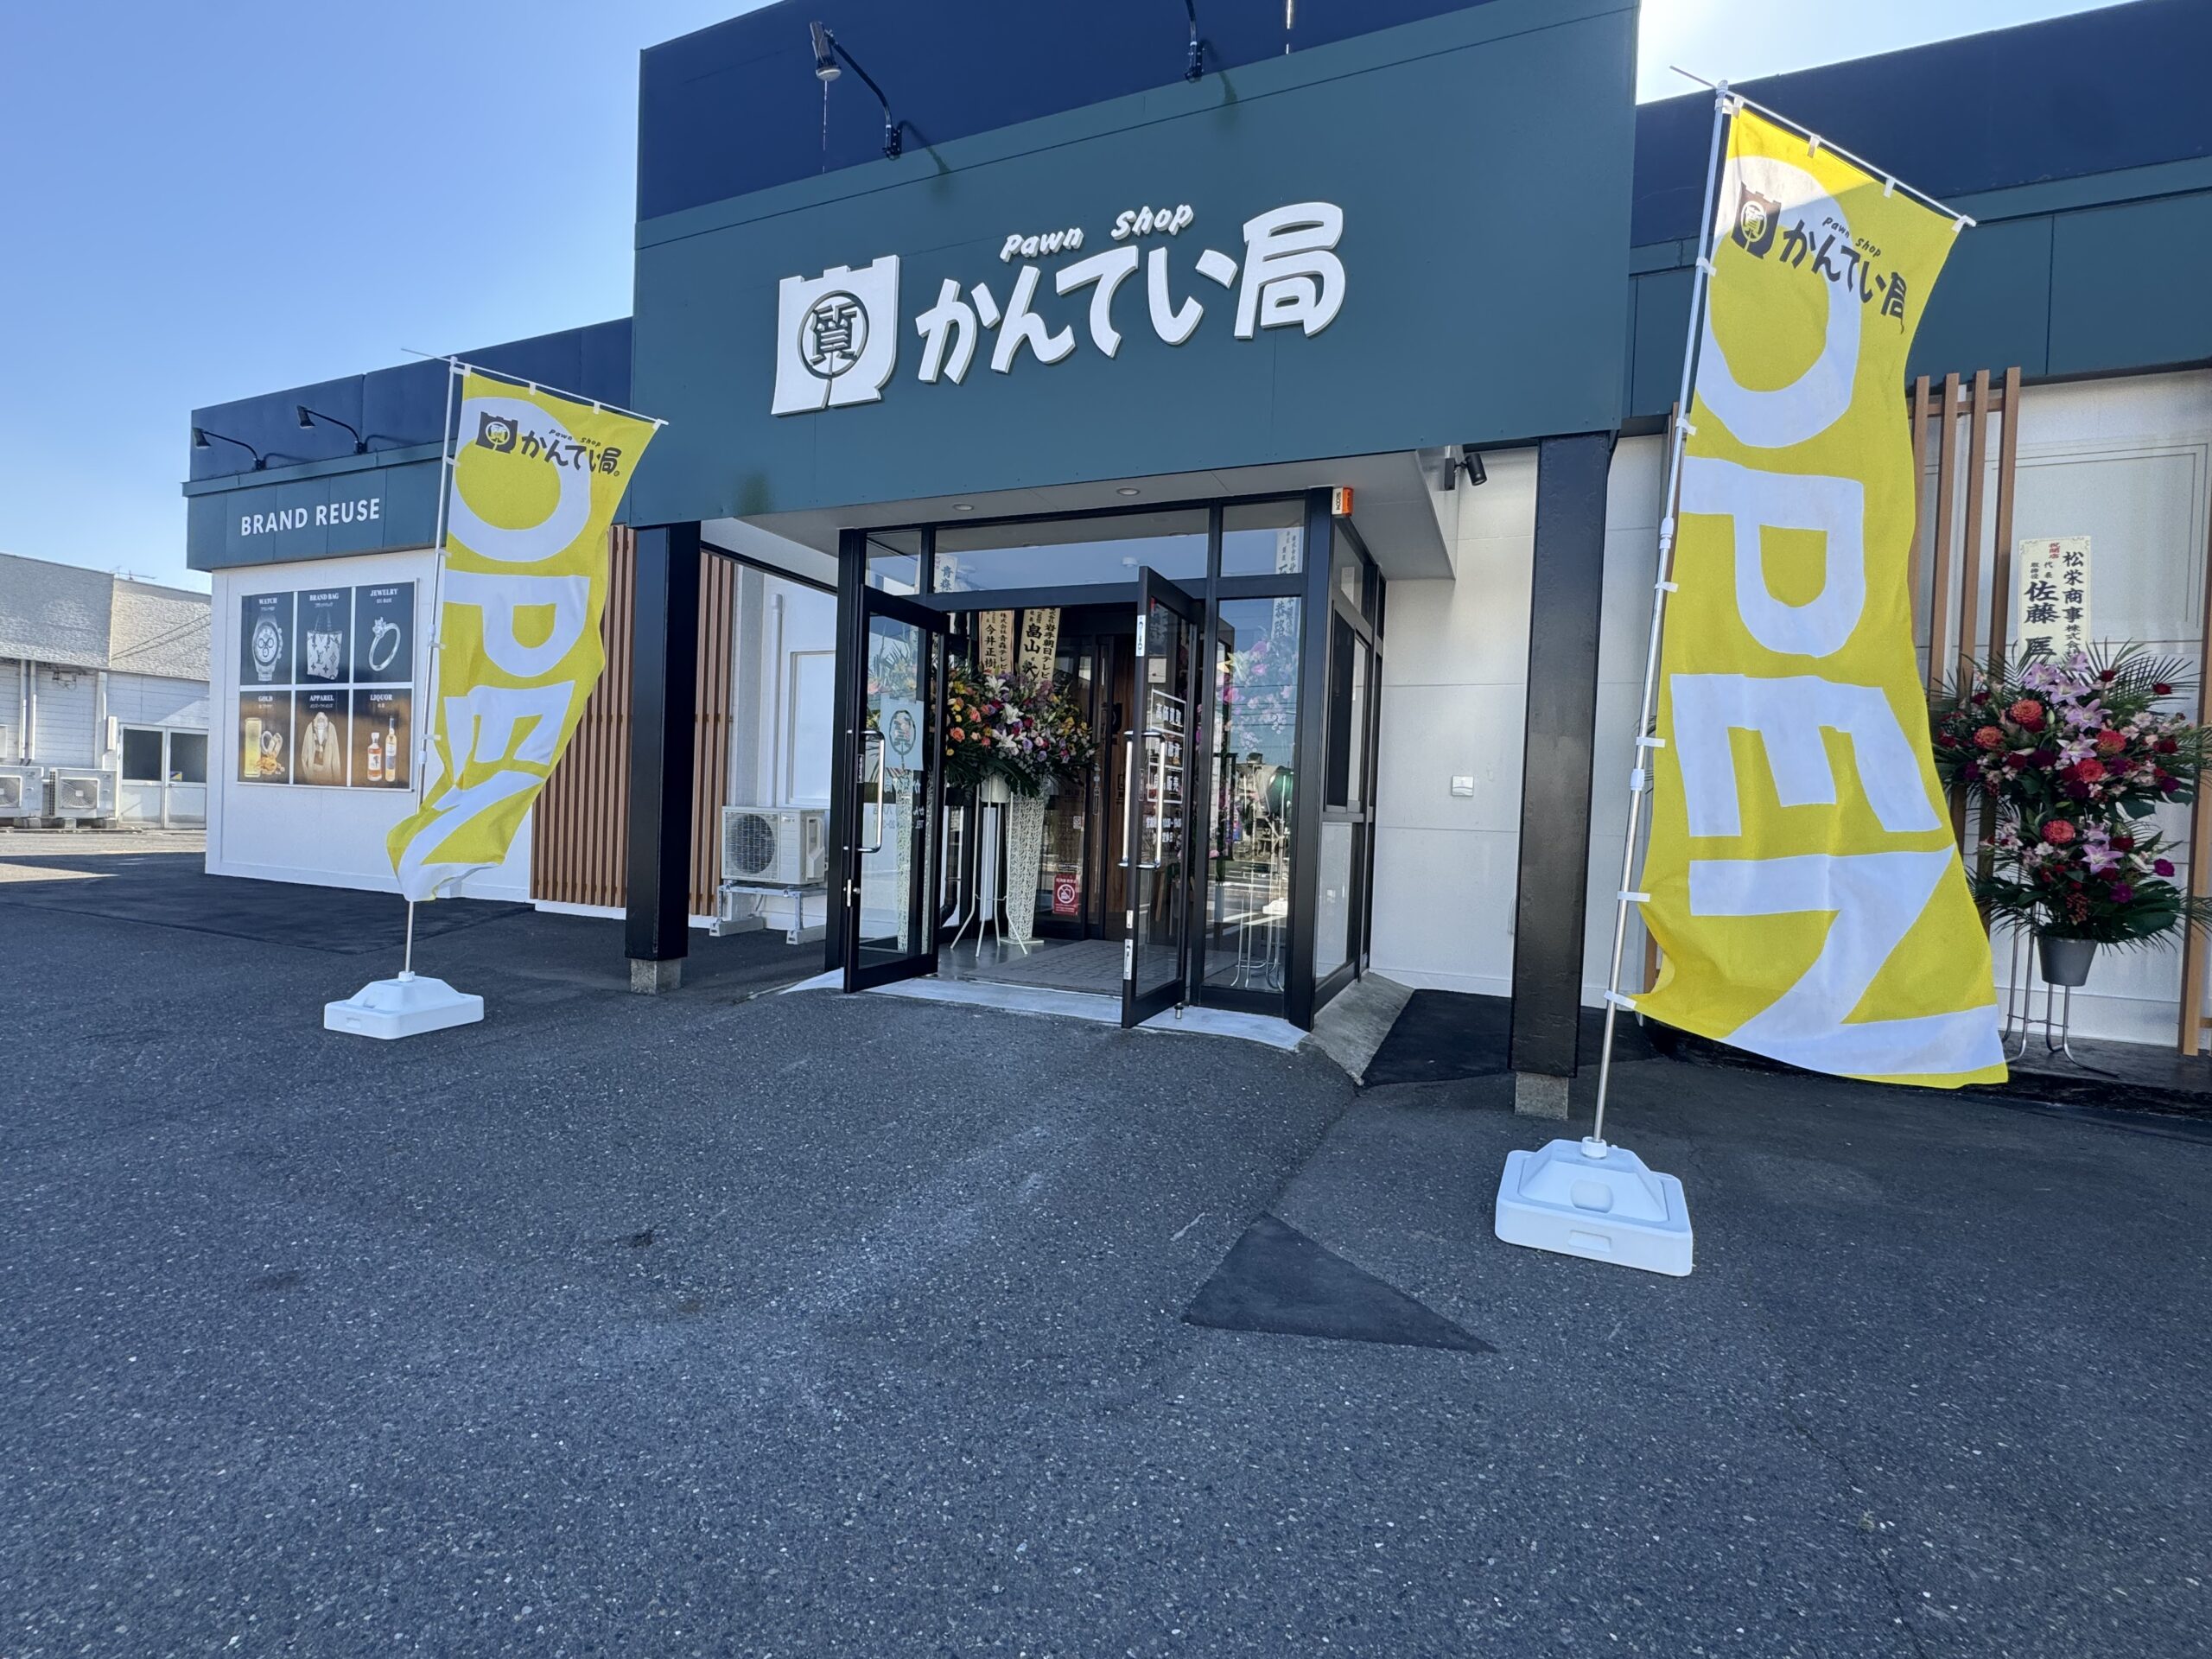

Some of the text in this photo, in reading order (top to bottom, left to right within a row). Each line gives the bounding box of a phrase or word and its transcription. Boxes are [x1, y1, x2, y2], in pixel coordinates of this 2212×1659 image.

[999, 203, 1194, 263] Pawn Shop
[1821, 216, 1882, 258] Pawn Shop
[1778, 219, 1908, 320] かんてい局
[914, 201, 1347, 385] かんてい局
[521, 430, 622, 475] かんてい局
[548, 429, 602, 448] Pawn Shop
[241, 498, 380, 536] BRAND REUSE
[370, 588, 398, 597] JEWELRY
[1669, 154, 2006, 1076] OPEN
[2024, 580, 2062, 625] 佐藤
